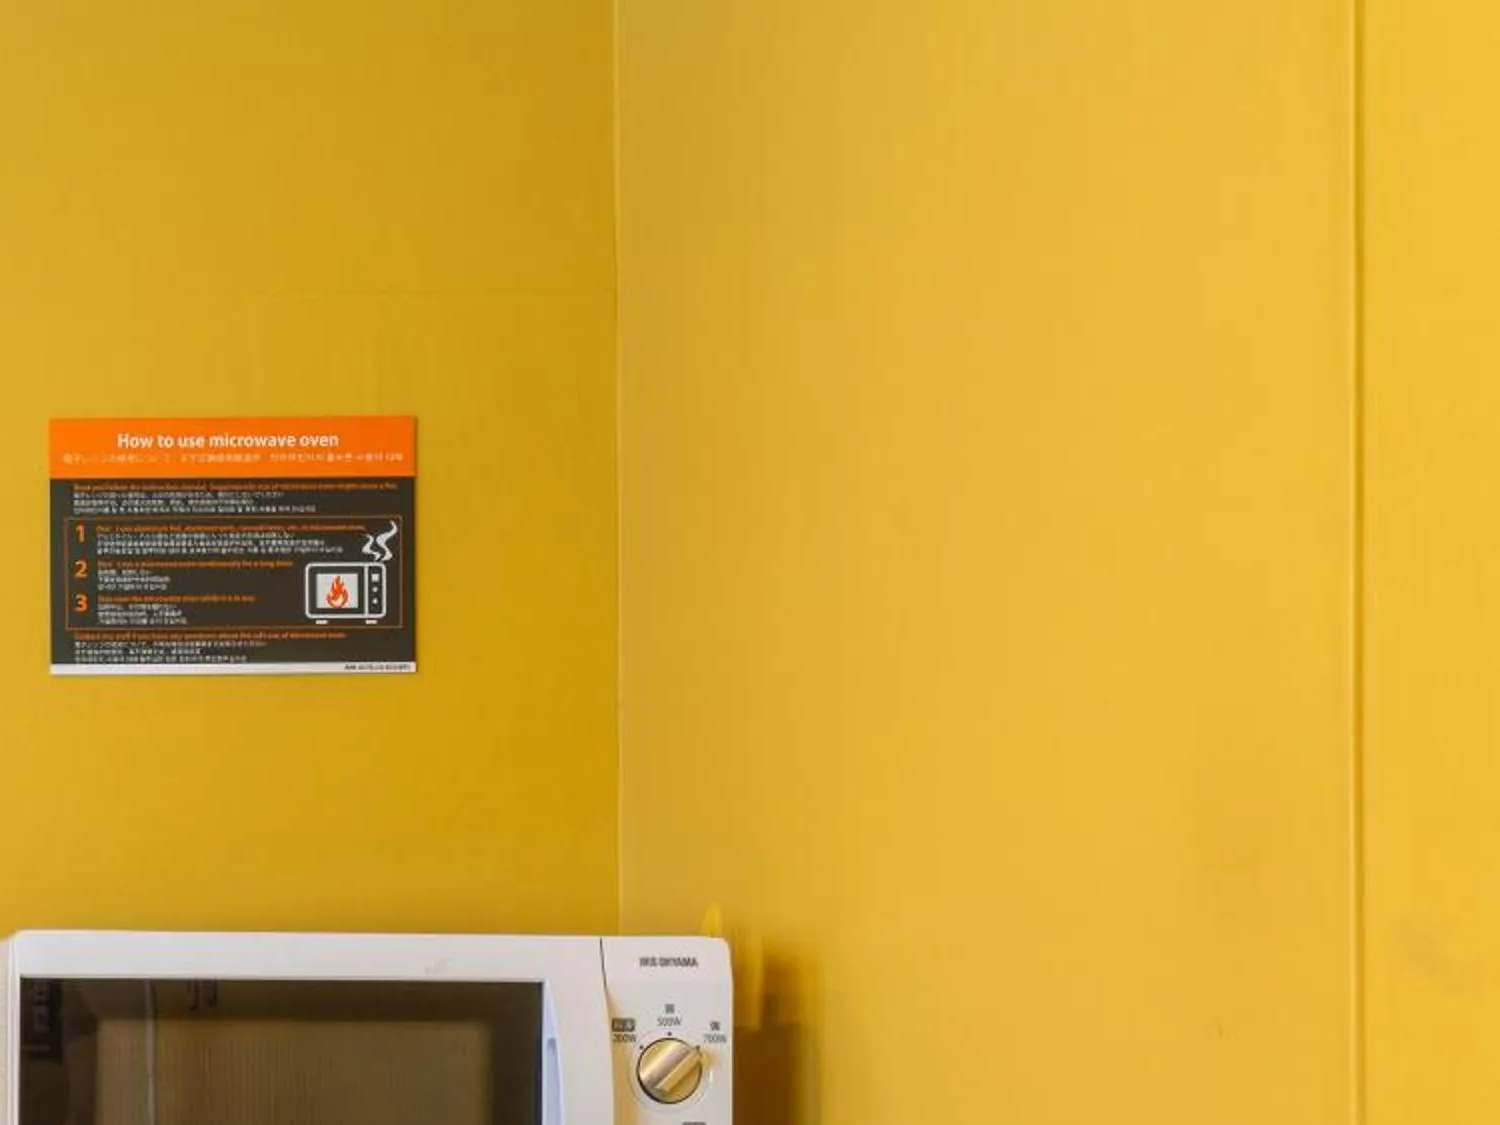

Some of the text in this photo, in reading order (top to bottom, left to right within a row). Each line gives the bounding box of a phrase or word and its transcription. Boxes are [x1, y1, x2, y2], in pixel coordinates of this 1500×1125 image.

[117, 434, 340, 448] How to use microwave oven
[76, 524, 85, 543] 1
[75, 560, 89, 578] 2
[75, 594, 88, 612] 3
[657, 1017, 682, 1027] 500W
